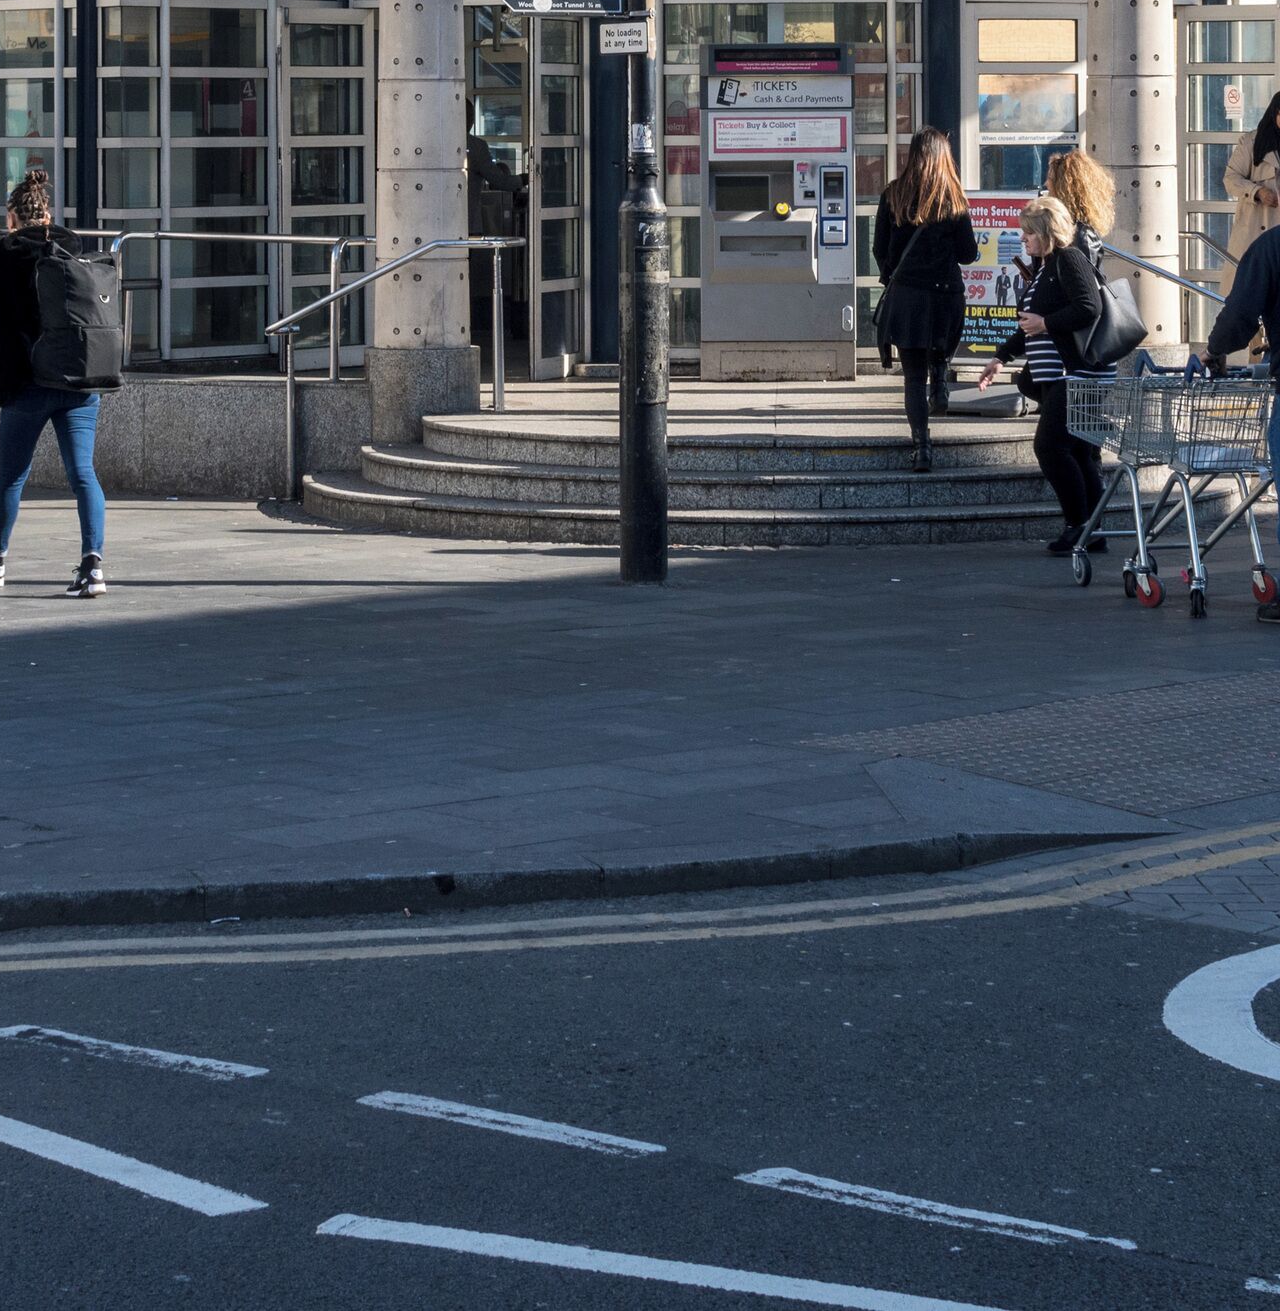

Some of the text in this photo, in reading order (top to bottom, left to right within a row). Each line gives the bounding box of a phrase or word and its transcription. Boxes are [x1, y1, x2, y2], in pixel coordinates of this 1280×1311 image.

[605, 28, 642, 38] No loading
[604, 39, 643, 49] at any time
[754, 80, 798, 91] TICKETS
[754, 95, 844, 105] Cash & Card Payments
[746, 121, 761, 131] Buy
[981, 134, 997, 142] When
[1018, 133, 1045, 141] alternative
[1046, 133, 1070, 141] entrance
[968, 206, 989, 217] rette
[970, 218, 984, 227] hed
[992, 218, 1008, 227] Iron
[964, 284, 986, 300] .99
[971, 306, 988, 317] DRY
[964, 317, 1020, 330] Day Dry Cleaning
